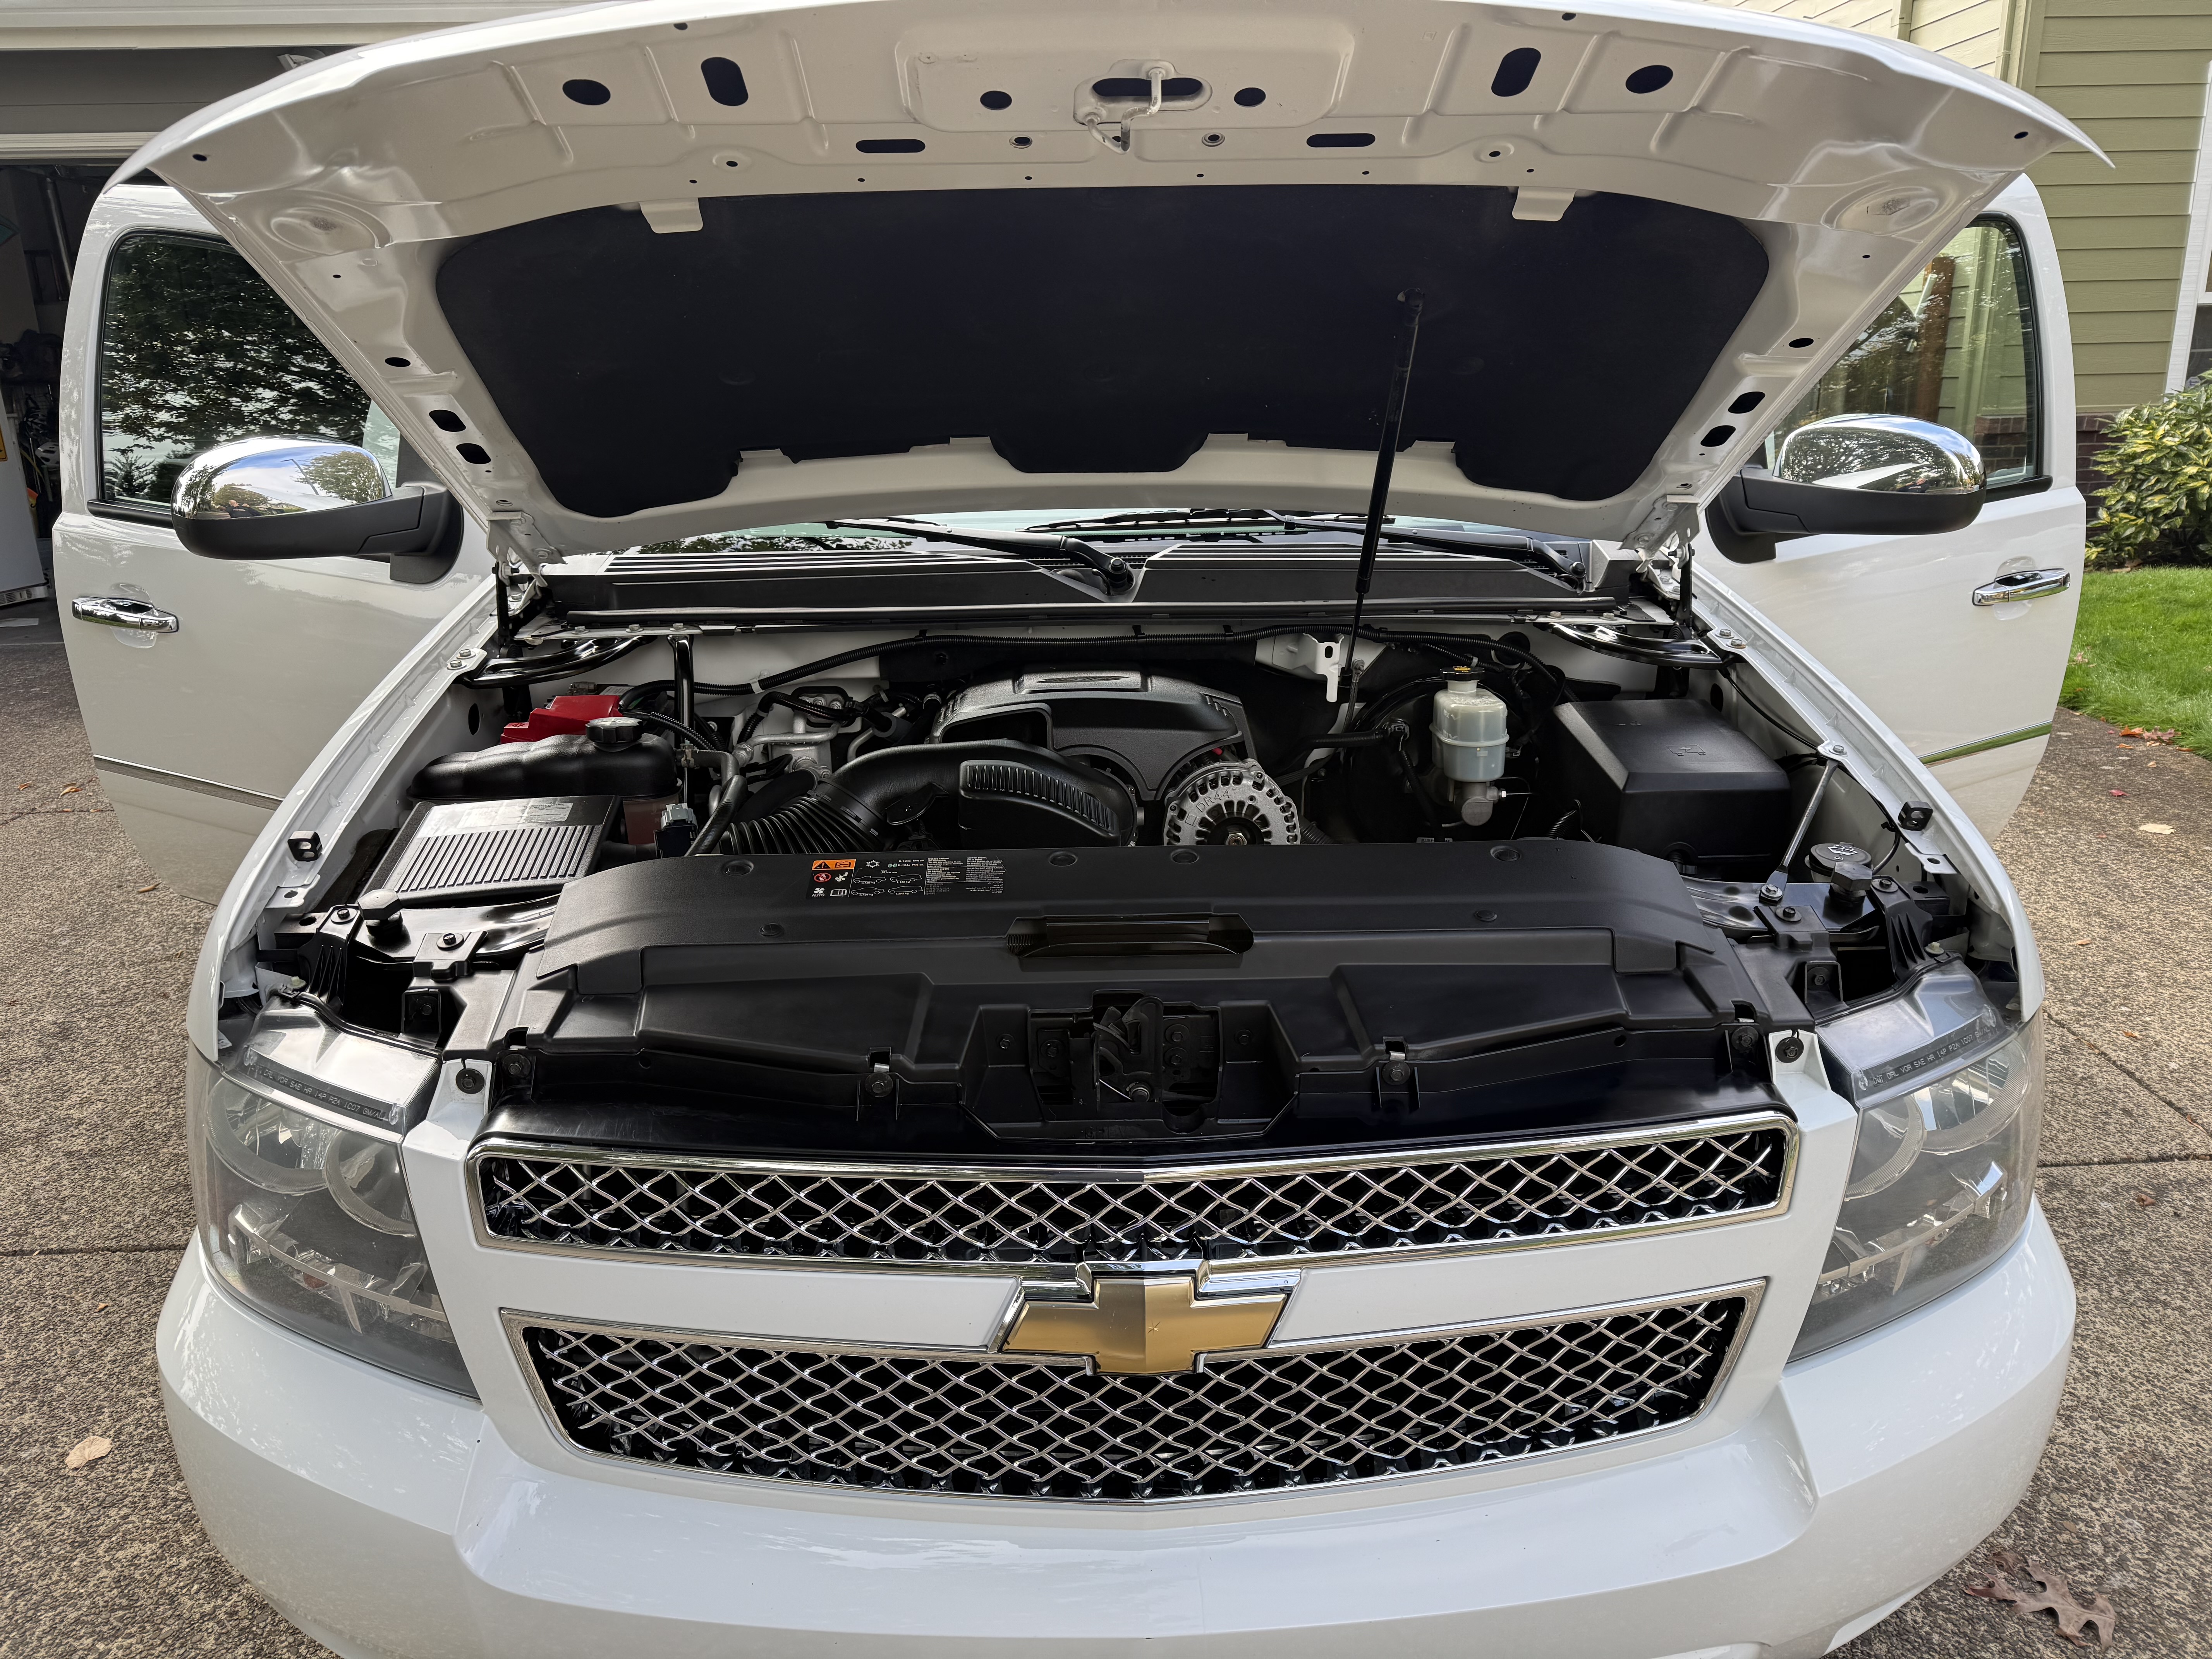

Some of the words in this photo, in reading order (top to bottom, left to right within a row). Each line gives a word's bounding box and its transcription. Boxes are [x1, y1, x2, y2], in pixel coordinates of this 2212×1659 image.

[1195, 788, 1231, 812] DR44
[1873, 1075, 1882, 1084] DOT
[1886, 1071, 1899, 1080] DRL
[1900, 1064, 1913, 1073] VOR
[1913, 1058, 1926, 1068] SAE
[264, 1069, 273, 1079] DRL
[277, 1075, 289, 1085] VOR
[290, 1081, 302, 1091] SAE
[303, 1087, 312, 1095] HR
[314, 1091, 326, 1099] 14P
[328, 1096, 340, 1105] P2A
[344, 1101, 361, 1111] 1C07
